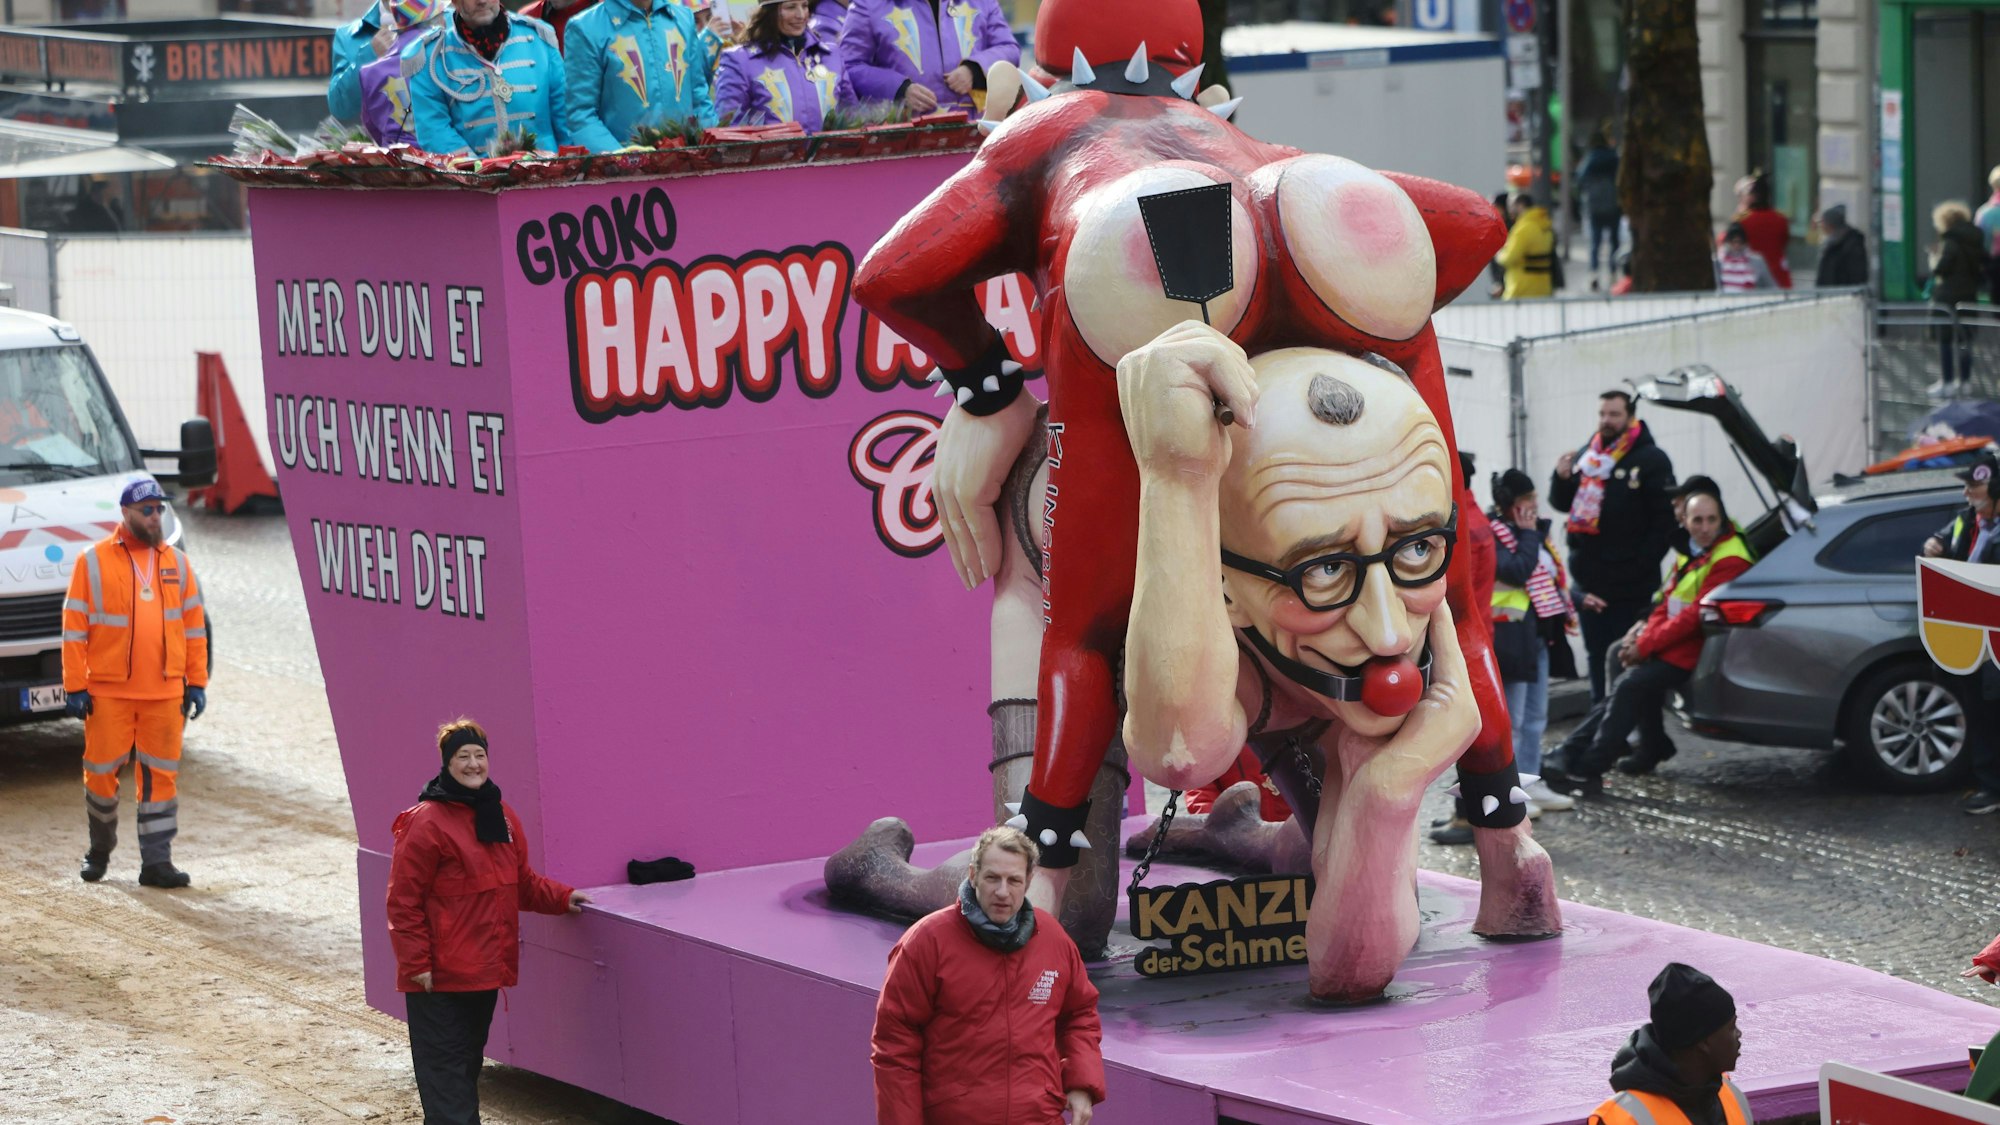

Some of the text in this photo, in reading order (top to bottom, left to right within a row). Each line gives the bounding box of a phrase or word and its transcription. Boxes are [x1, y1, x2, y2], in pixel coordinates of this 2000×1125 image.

[166, 37, 330, 81] BRENNWER
[517, 187, 677, 285] GROKO
[276, 279, 483, 367] MER DUN ET
[572, 246, 848, 414] HAPPY
[275, 393, 504, 496] UCH WENN ET
[311, 518, 486, 620] WIEH DEIT
[31, 690, 40, 706] K
[1143, 951, 1182, 974] der
